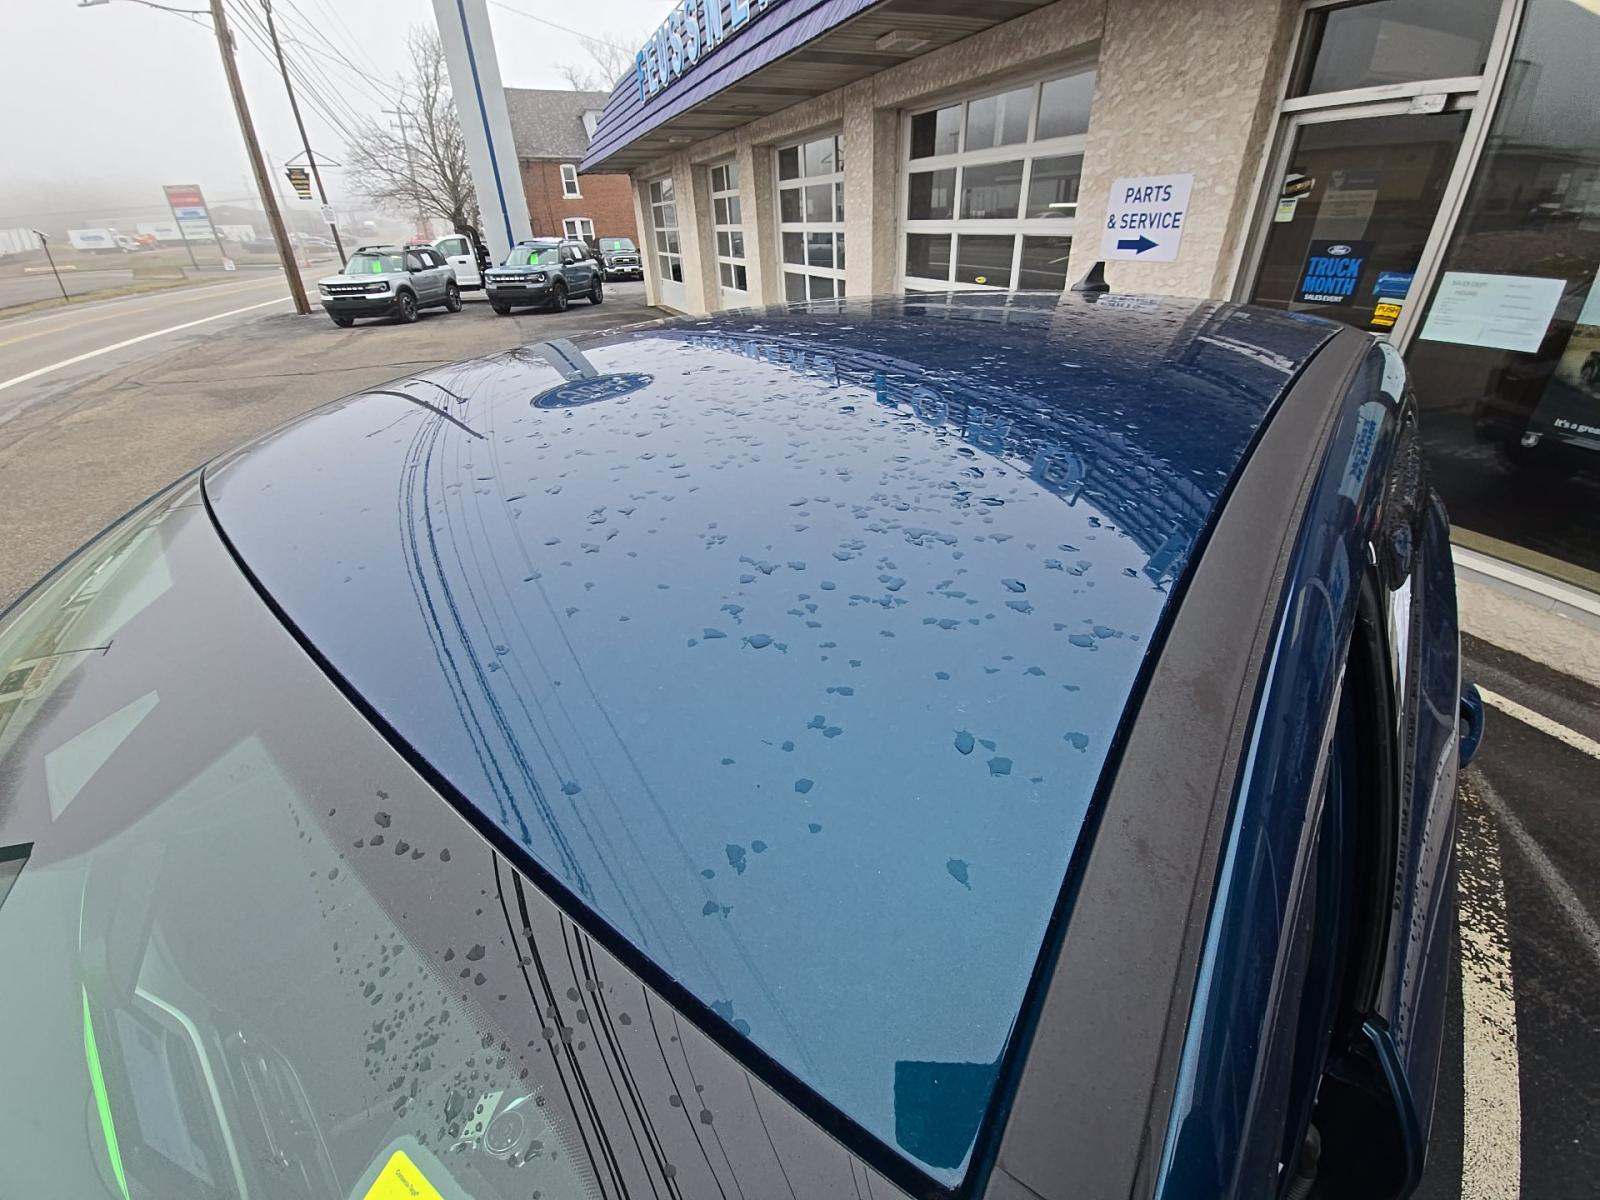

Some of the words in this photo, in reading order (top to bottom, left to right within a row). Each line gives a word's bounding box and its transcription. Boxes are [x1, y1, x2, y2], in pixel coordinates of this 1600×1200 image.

[636, 0, 769, 105] FEUSSN
[1124, 185, 1172, 203] PARTS
[1107, 213, 1116, 229] &
[1119, 211, 1183, 229] SERVICE
[1307, 257, 1362, 277] TRUCK
[1302, 276, 1356, 295] MONTH
[1303, 293, 1322, 301] SALES
[1378, 304, 1400, 314] PUSH
